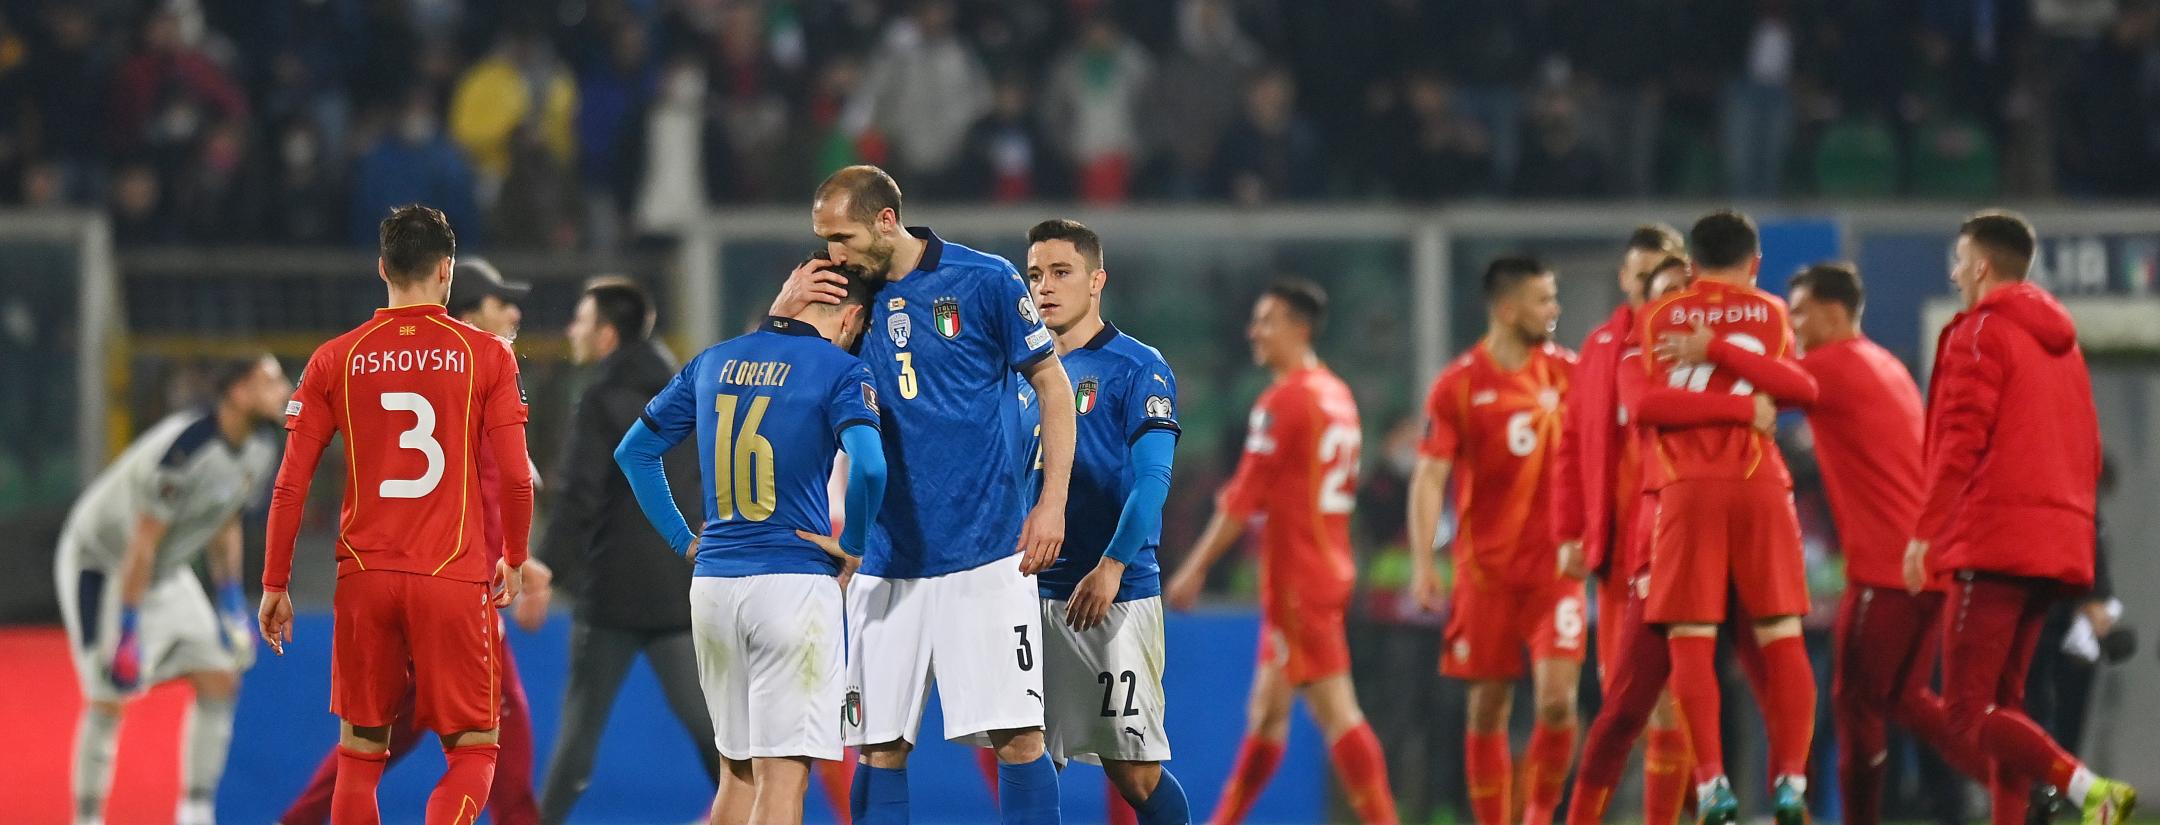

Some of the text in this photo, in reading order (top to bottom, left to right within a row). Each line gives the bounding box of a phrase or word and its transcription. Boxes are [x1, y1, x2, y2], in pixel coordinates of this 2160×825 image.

[352, 349, 464, 376] ASKOVSKI
[719, 360, 791, 386] FLORENZI
[895, 352, 918, 400] 3
[380, 392, 446, 499] 3
[1033, 424, 1044, 470] 2
[1508, 411, 1537, 457] 6
[715, 393, 776, 522] 16
[1555, 597, 1582, 637] 6
[1014, 625, 1033, 672] 3
[1098, 670, 1139, 717] 22
